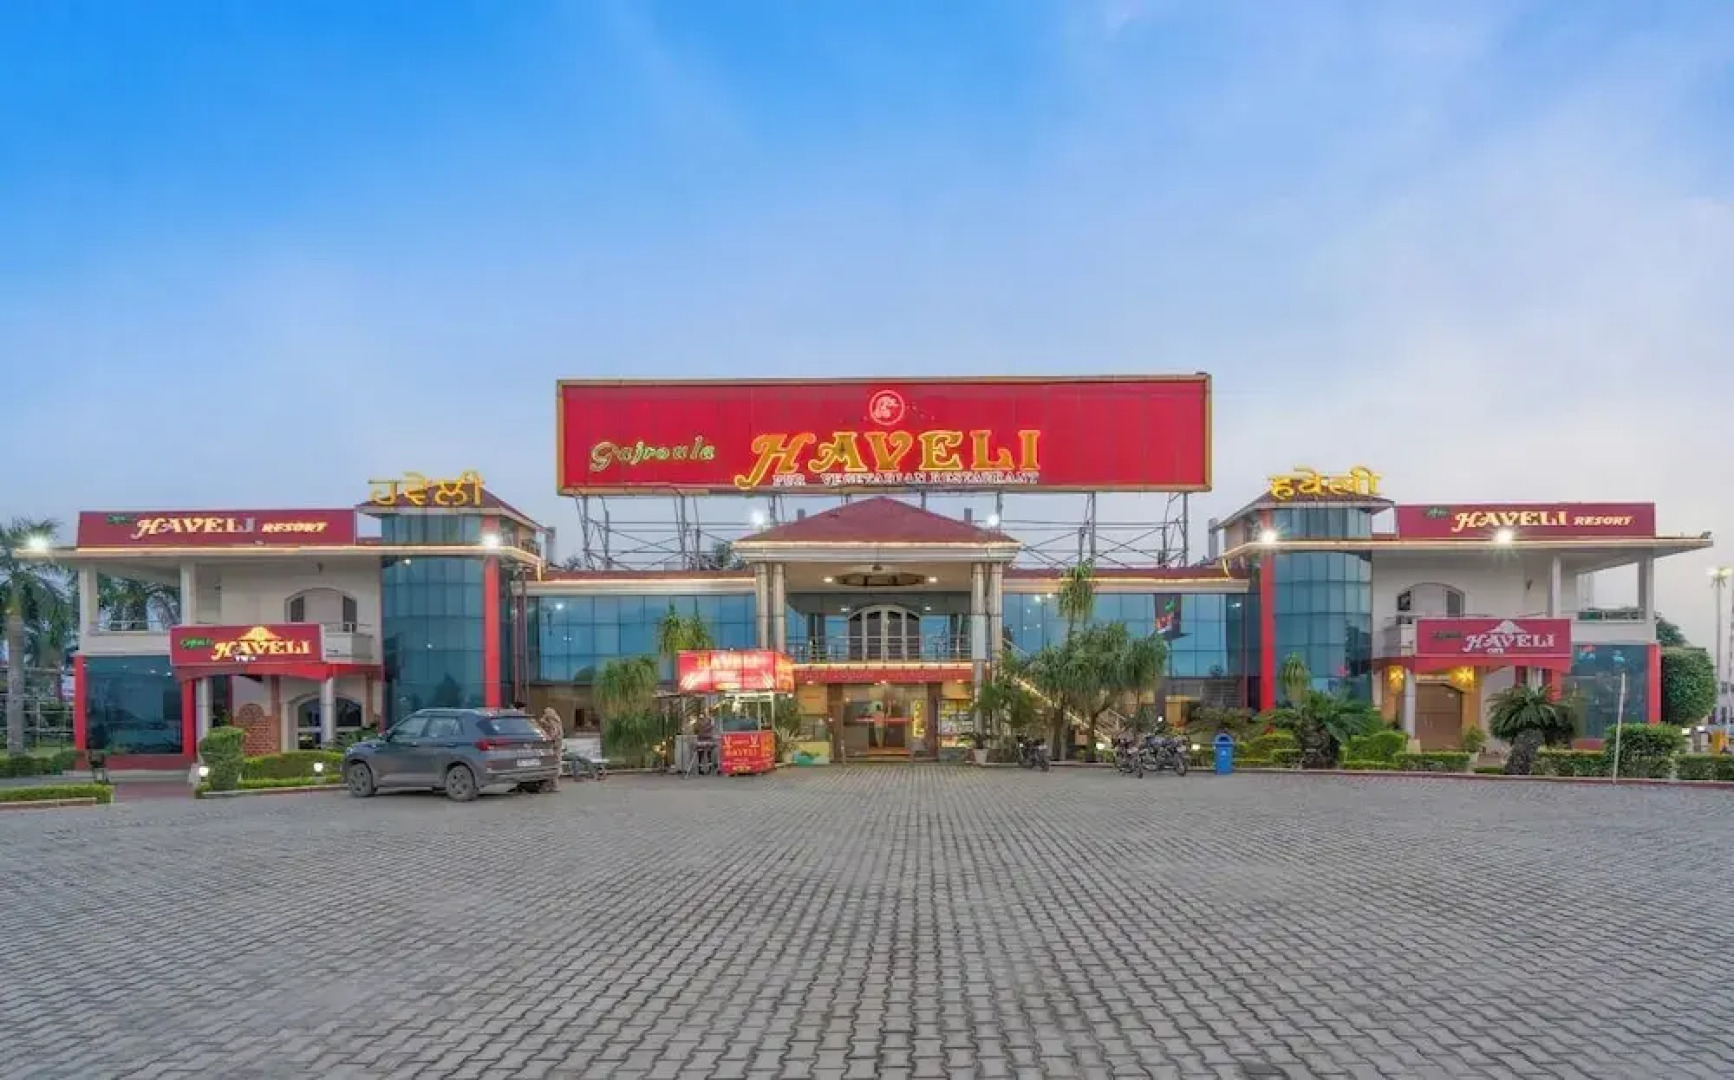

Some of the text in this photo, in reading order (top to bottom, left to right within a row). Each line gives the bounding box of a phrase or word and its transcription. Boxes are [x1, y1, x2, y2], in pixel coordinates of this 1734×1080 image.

[734, 429, 1042, 490] HAVELI
[368, 470, 485, 506] ਹਵੇਲੀ
[1268, 464, 1382, 500] हवेली
[131, 516, 256, 540] HAVELI
[261, 521, 328, 533] RESORT
[1451, 510, 1568, 533] HAVELI
[1573, 516, 1633, 526] RESORT
[211, 639, 311, 661] HAVELI
[1462, 633, 1556, 653] HAVELI
